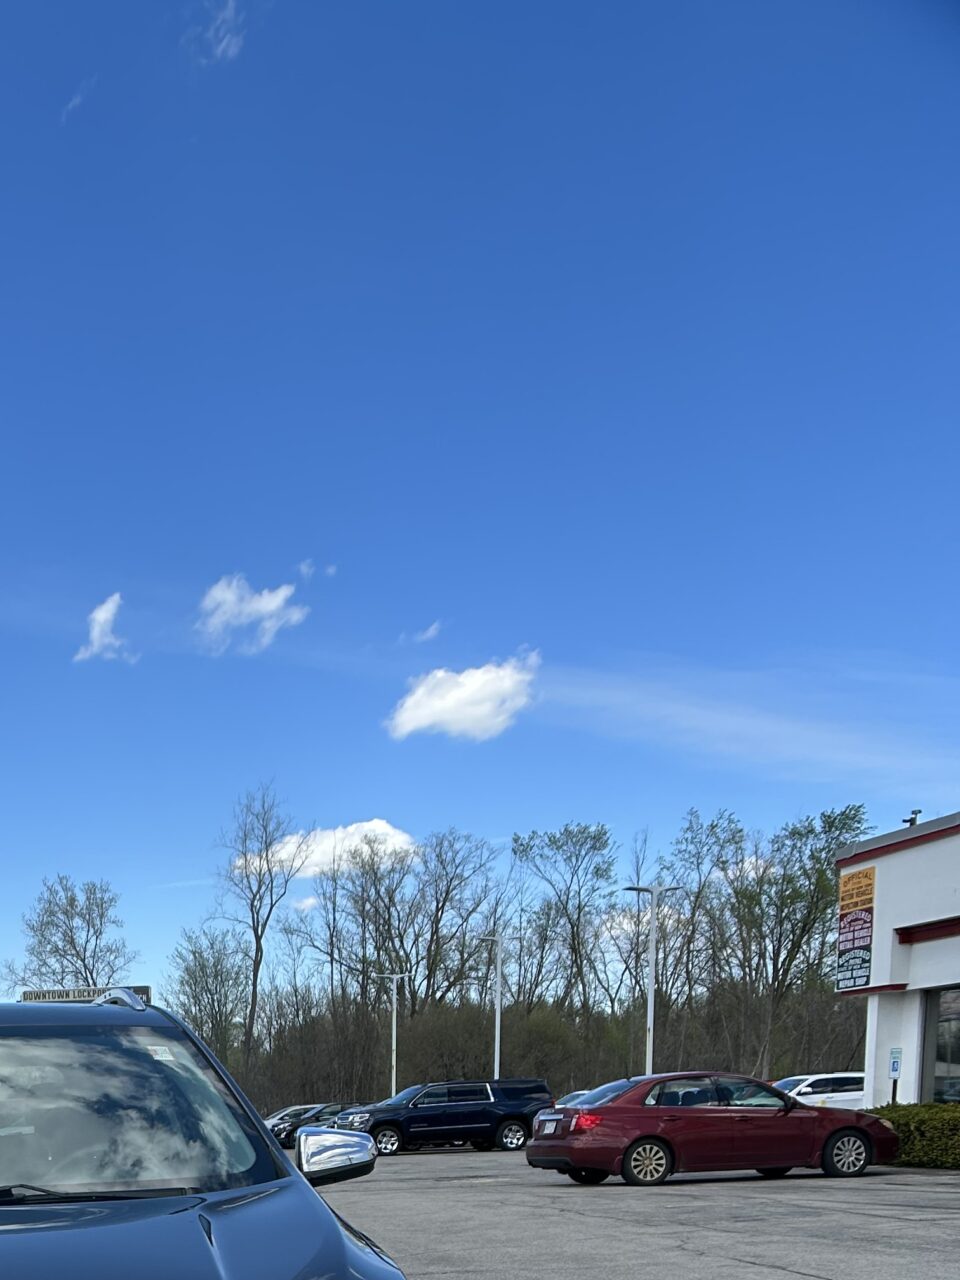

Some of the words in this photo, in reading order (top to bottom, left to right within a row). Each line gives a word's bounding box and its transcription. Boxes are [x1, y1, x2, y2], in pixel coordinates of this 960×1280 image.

[843, 871, 873, 887] OFFICIAL
[840, 910, 871, 928] REGISTERED
[839, 949, 870, 966] REGISTERED
[23, 990, 70, 1001] DOWNTOWN
[73, 988, 108, 999] LOCKPOR
